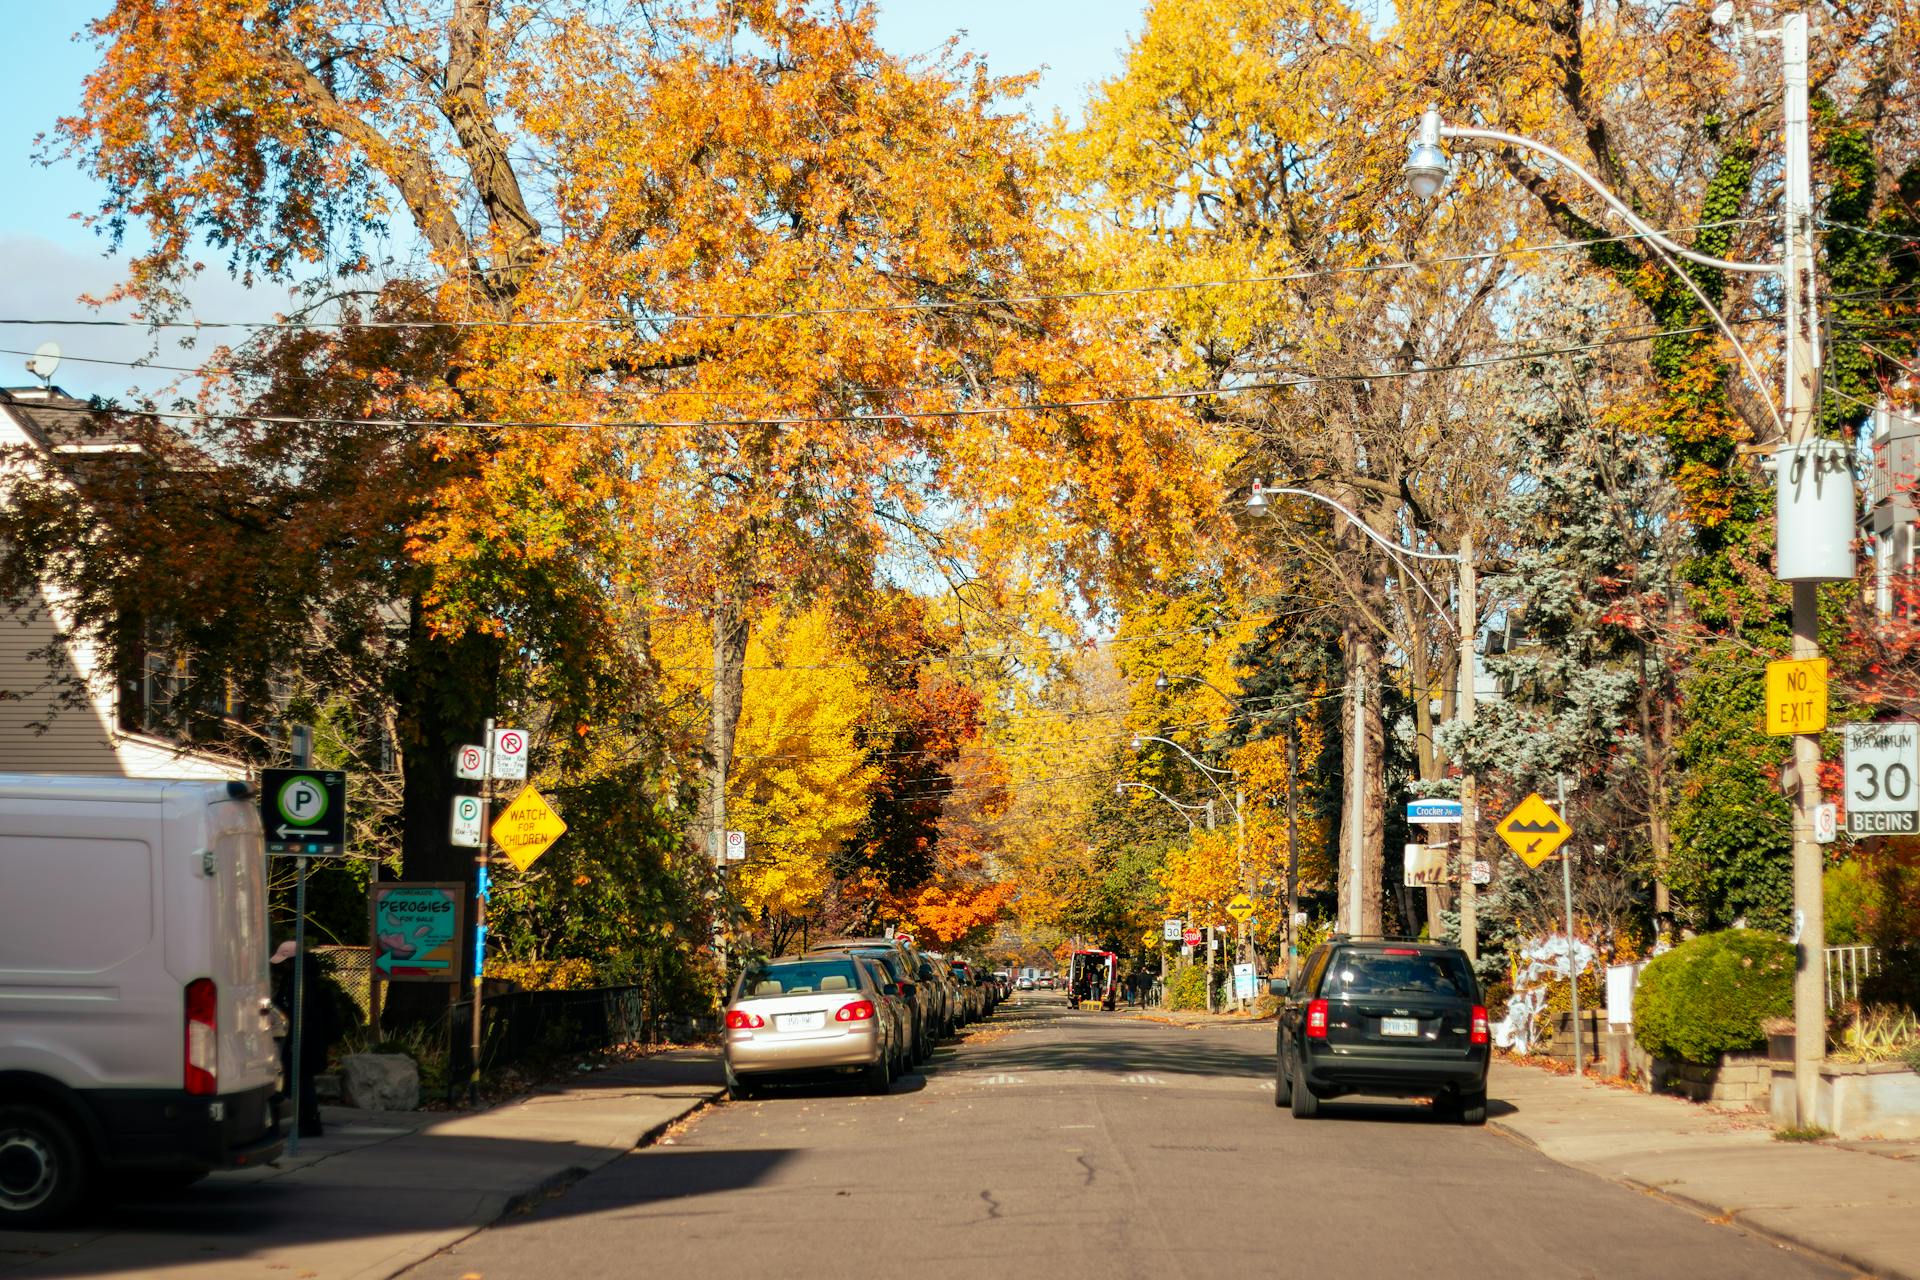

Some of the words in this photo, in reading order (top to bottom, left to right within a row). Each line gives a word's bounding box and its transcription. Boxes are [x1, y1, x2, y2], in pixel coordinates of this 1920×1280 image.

[1787, 671, 1807, 692] NO
[1780, 701, 1813, 723] EXIT
[1852, 734, 1912, 749] MAXIMUM
[1855, 763, 1911, 802] 30
[296, 790, 312, 812] P
[510, 809, 547, 822] WATCH
[1416, 806, 1443, 816] Crocker
[518, 822, 535, 832] FOR
[1854, 812, 1913, 832] BEGINS
[503, 834, 548, 847] CHILDREN
[380, 901, 451, 913] PEROGIES
[1167, 928, 1179, 937] 30
[1184, 933, 1201, 941] STOP
